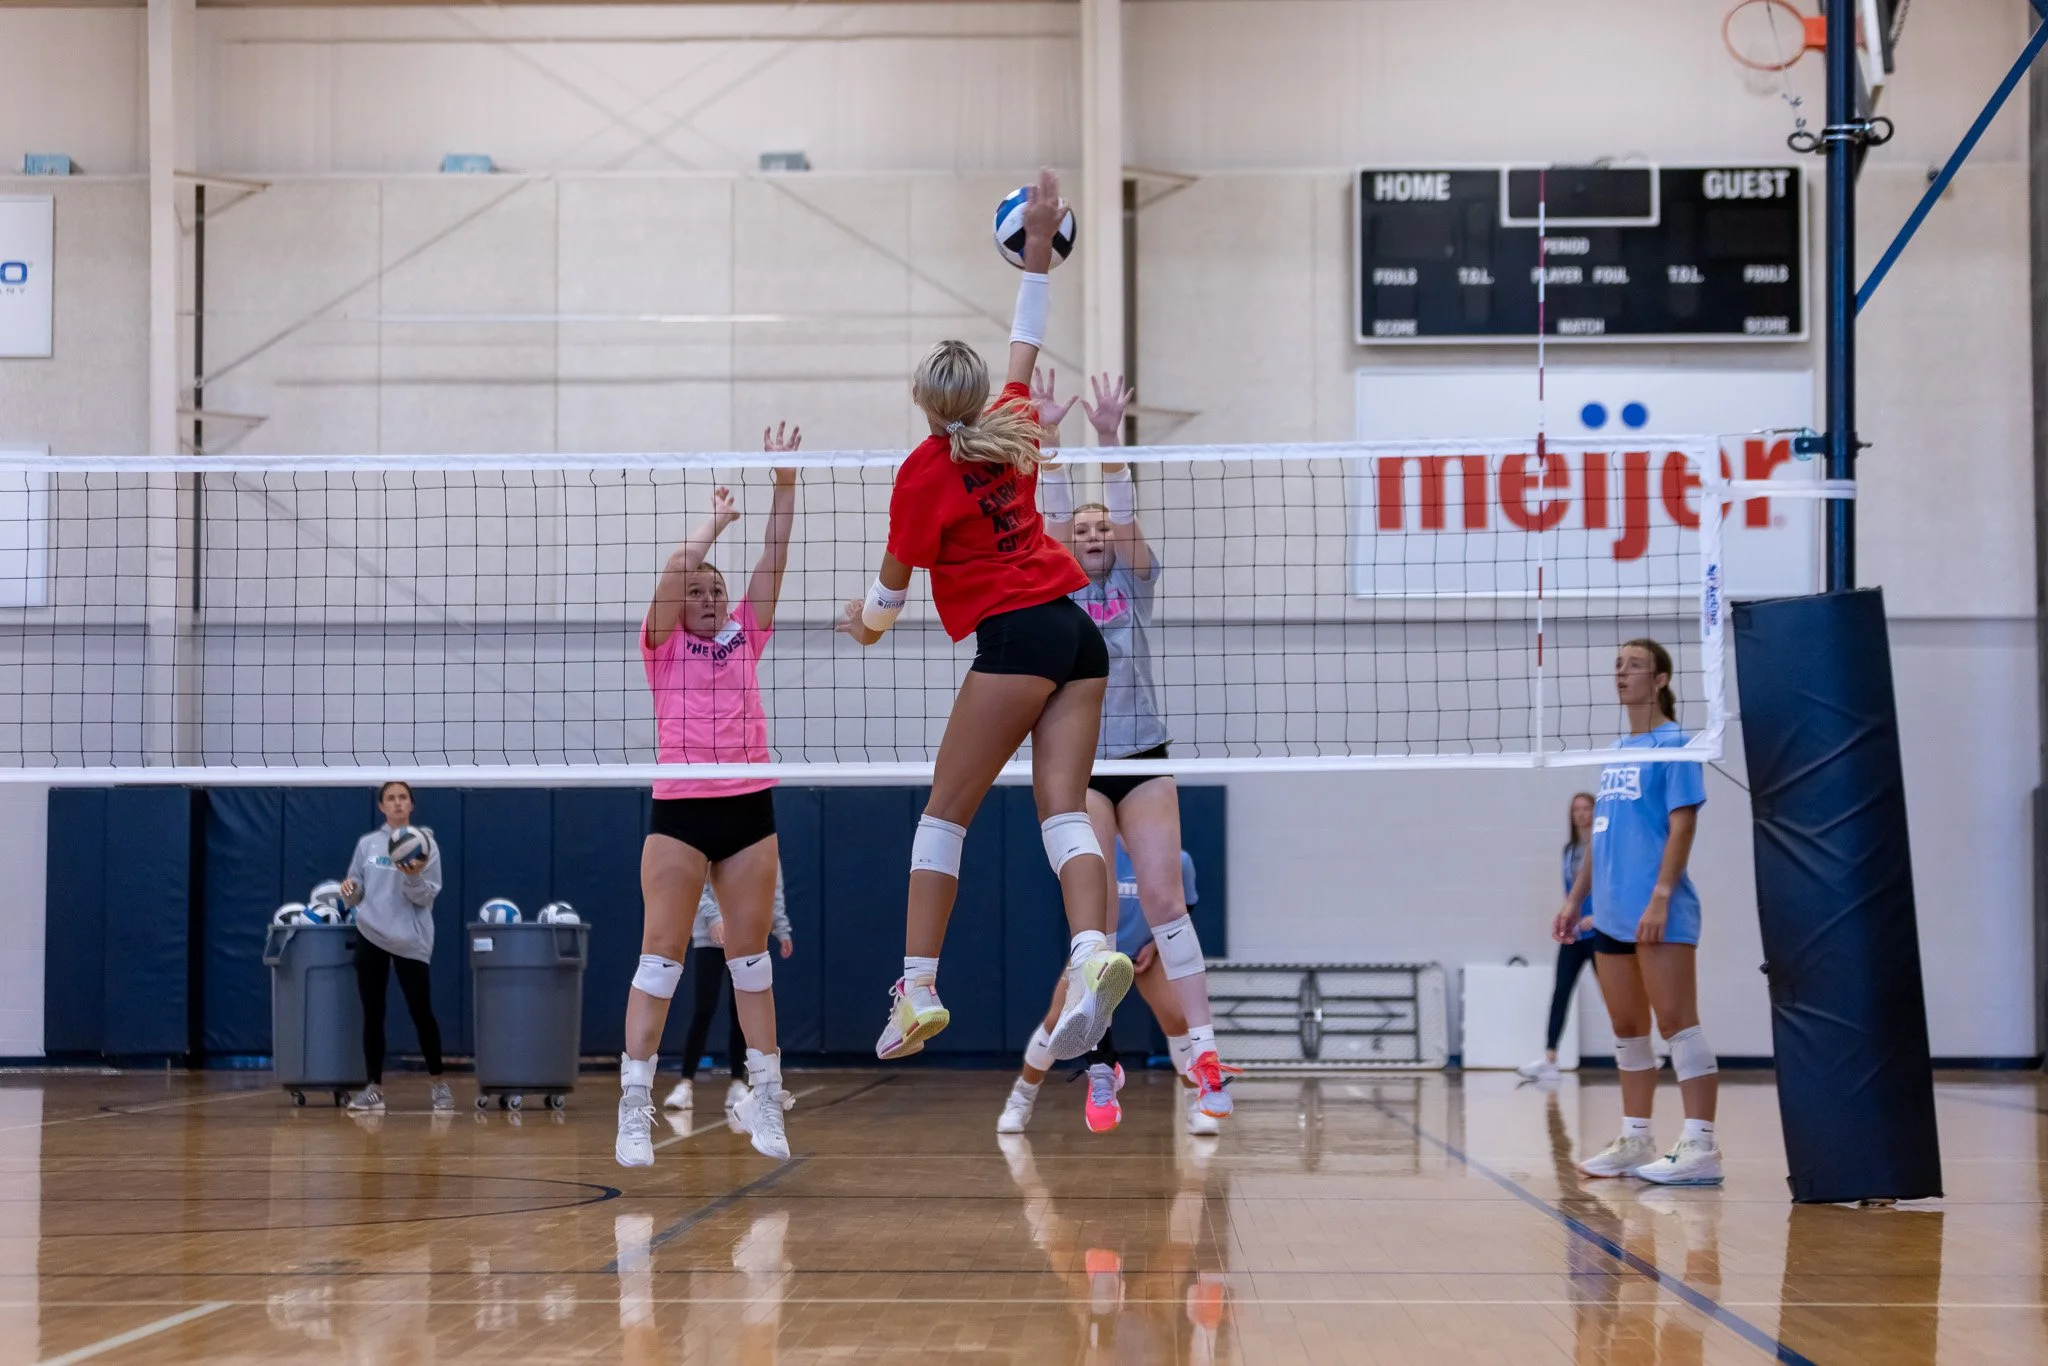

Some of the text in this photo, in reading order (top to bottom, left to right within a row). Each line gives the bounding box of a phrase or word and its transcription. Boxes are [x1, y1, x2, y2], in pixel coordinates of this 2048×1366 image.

[1374, 172, 1451, 201] HOME
[1703, 169, 1790, 199] GUEST
[1543, 236, 1590, 255] PERIOD
[1372, 267, 1418, 286] FOULS
[1530, 265, 1583, 285] PLAYER
[1743, 264, 1790, 283] FOULS
[1372, 318, 1418, 336] SCORE
[1556, 318, 1605, 335] MATCH
[1743, 315, 1790, 335] SCORE
[1377, 401, 1793, 562] meijer
